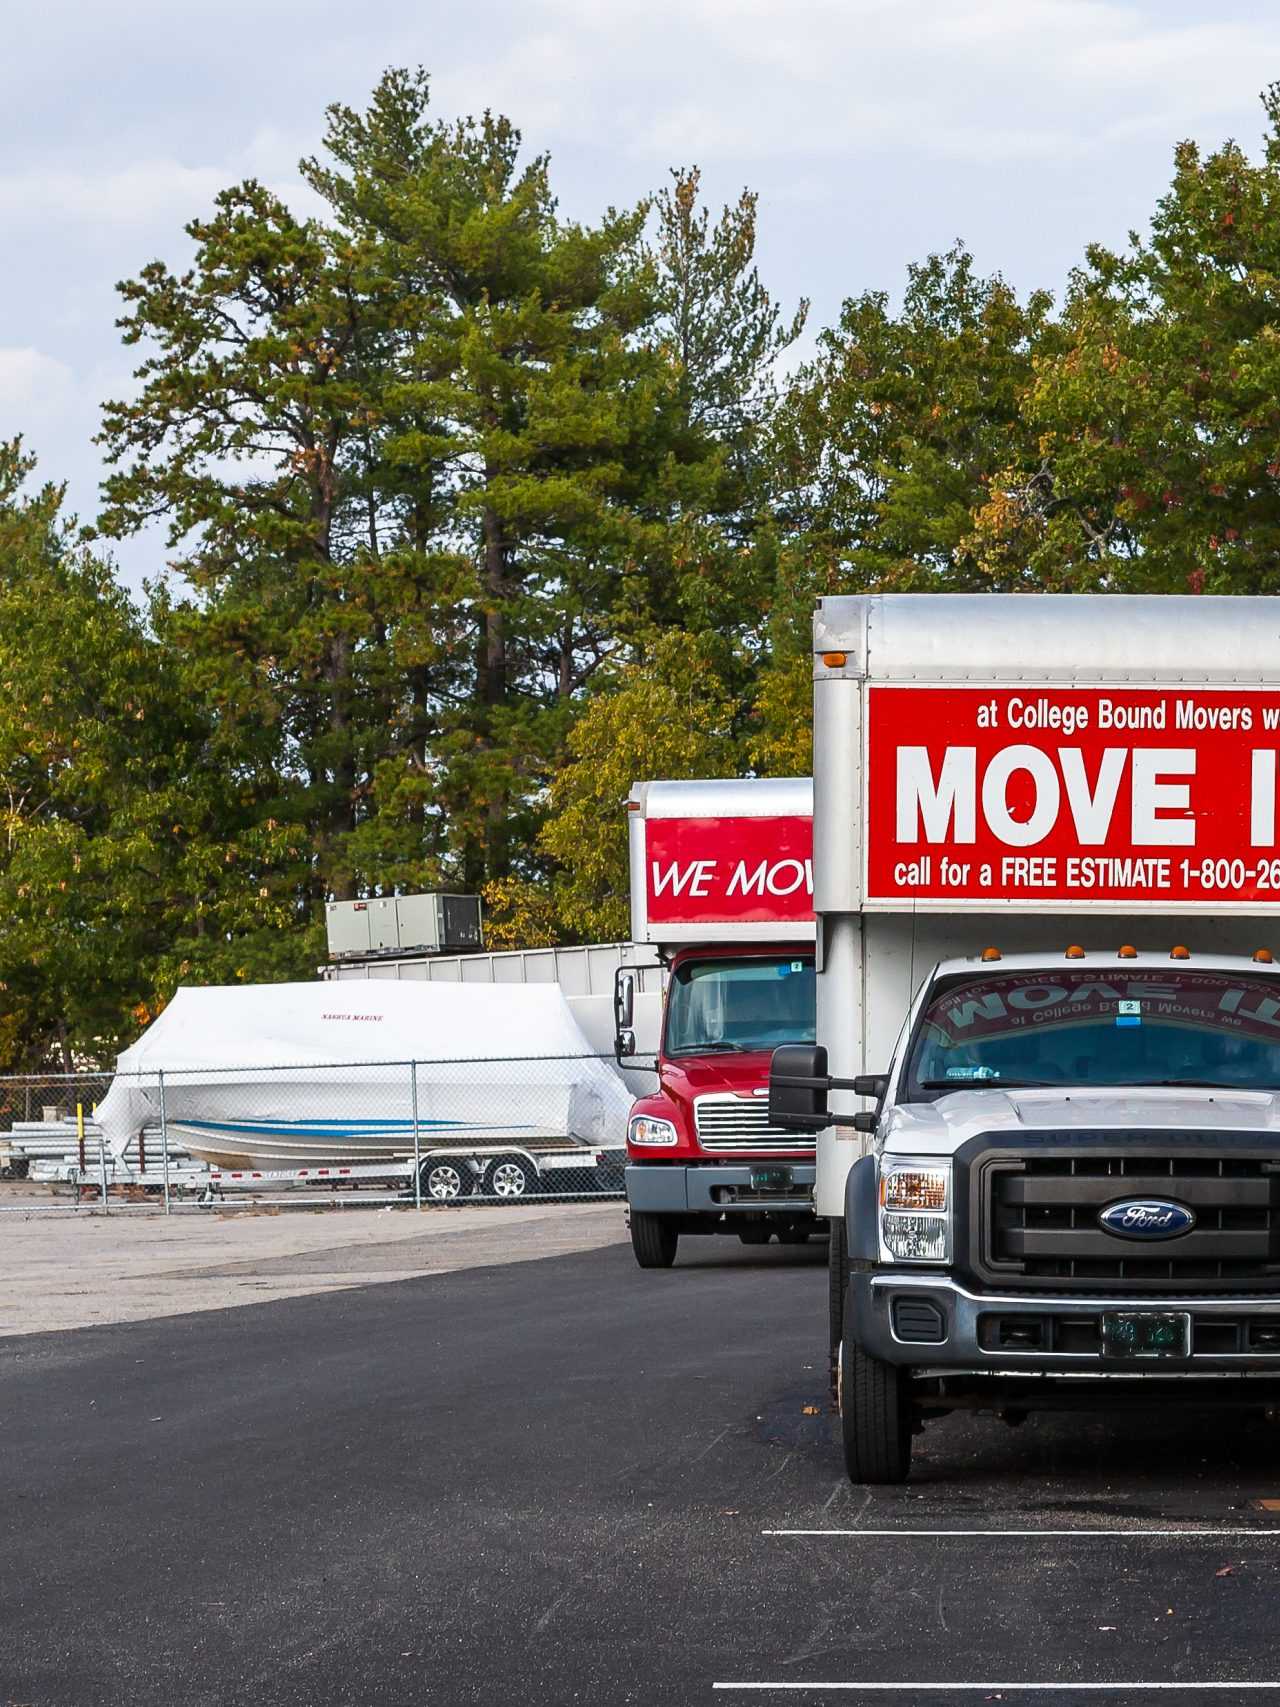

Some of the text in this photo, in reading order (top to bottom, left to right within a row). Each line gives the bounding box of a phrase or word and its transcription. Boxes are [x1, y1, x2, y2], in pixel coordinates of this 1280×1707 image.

[976, 699, 998, 729] at
[1007, 697, 1089, 736] College
[1098, 699, 1166, 730] Bound
[1175, 699, 1253, 731] Movers
[896, 744, 1197, 847] MOVE
[652, 859, 717, 897] WE
[894, 856, 931, 887] call
[939, 856, 971, 887] for
[979, 863, 992, 887] a
[1001, 857, 1057, 888] FREE
[1066, 857, 1171, 889] ESTIMATE
[1122, 1206, 1173, 1227] Ford
